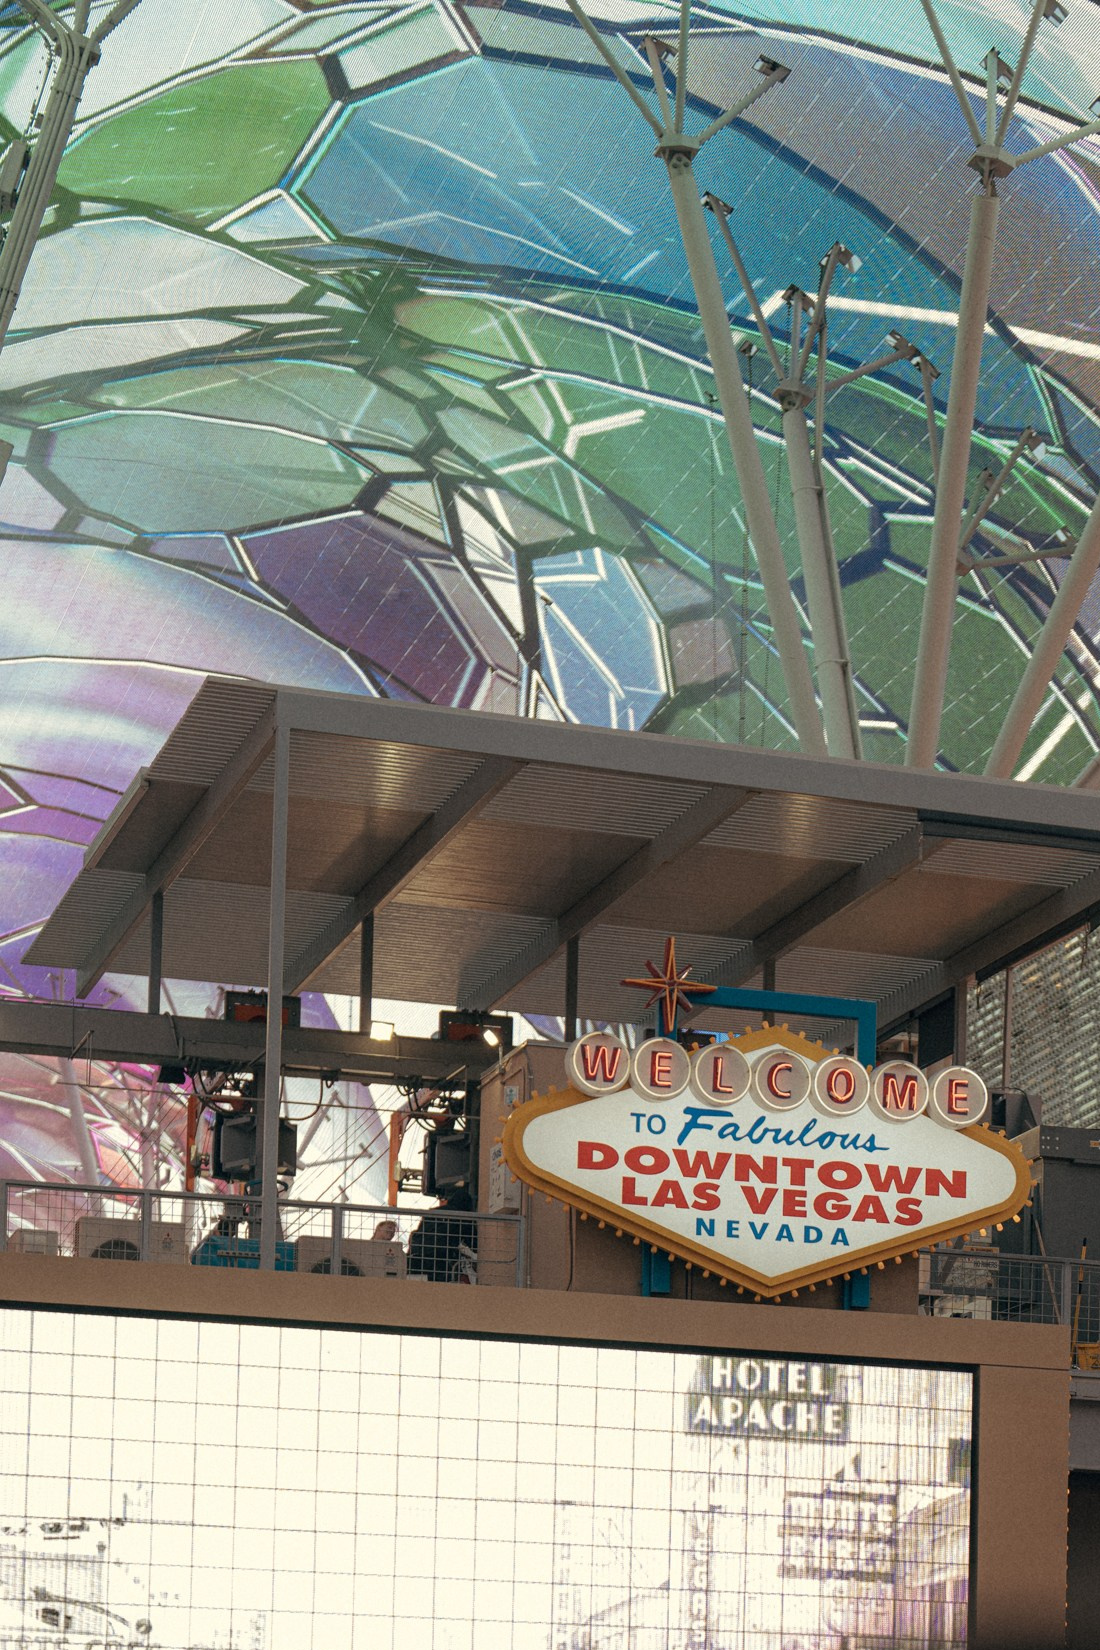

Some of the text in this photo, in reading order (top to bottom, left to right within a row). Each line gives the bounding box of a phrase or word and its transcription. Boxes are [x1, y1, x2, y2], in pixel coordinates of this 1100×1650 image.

[580, 1043, 970, 1115] WELCOME
[630, 1106, 891, 1152] TO Fabulous
[577, 1141, 968, 1199] DOWNTOWN
[621, 1176, 923, 1226] LAS VEGAS
[696, 1217, 851, 1247] NEVADA
[711, 1356, 830, 1396] HOTEL
[693, 1395, 845, 1434] APACHE
